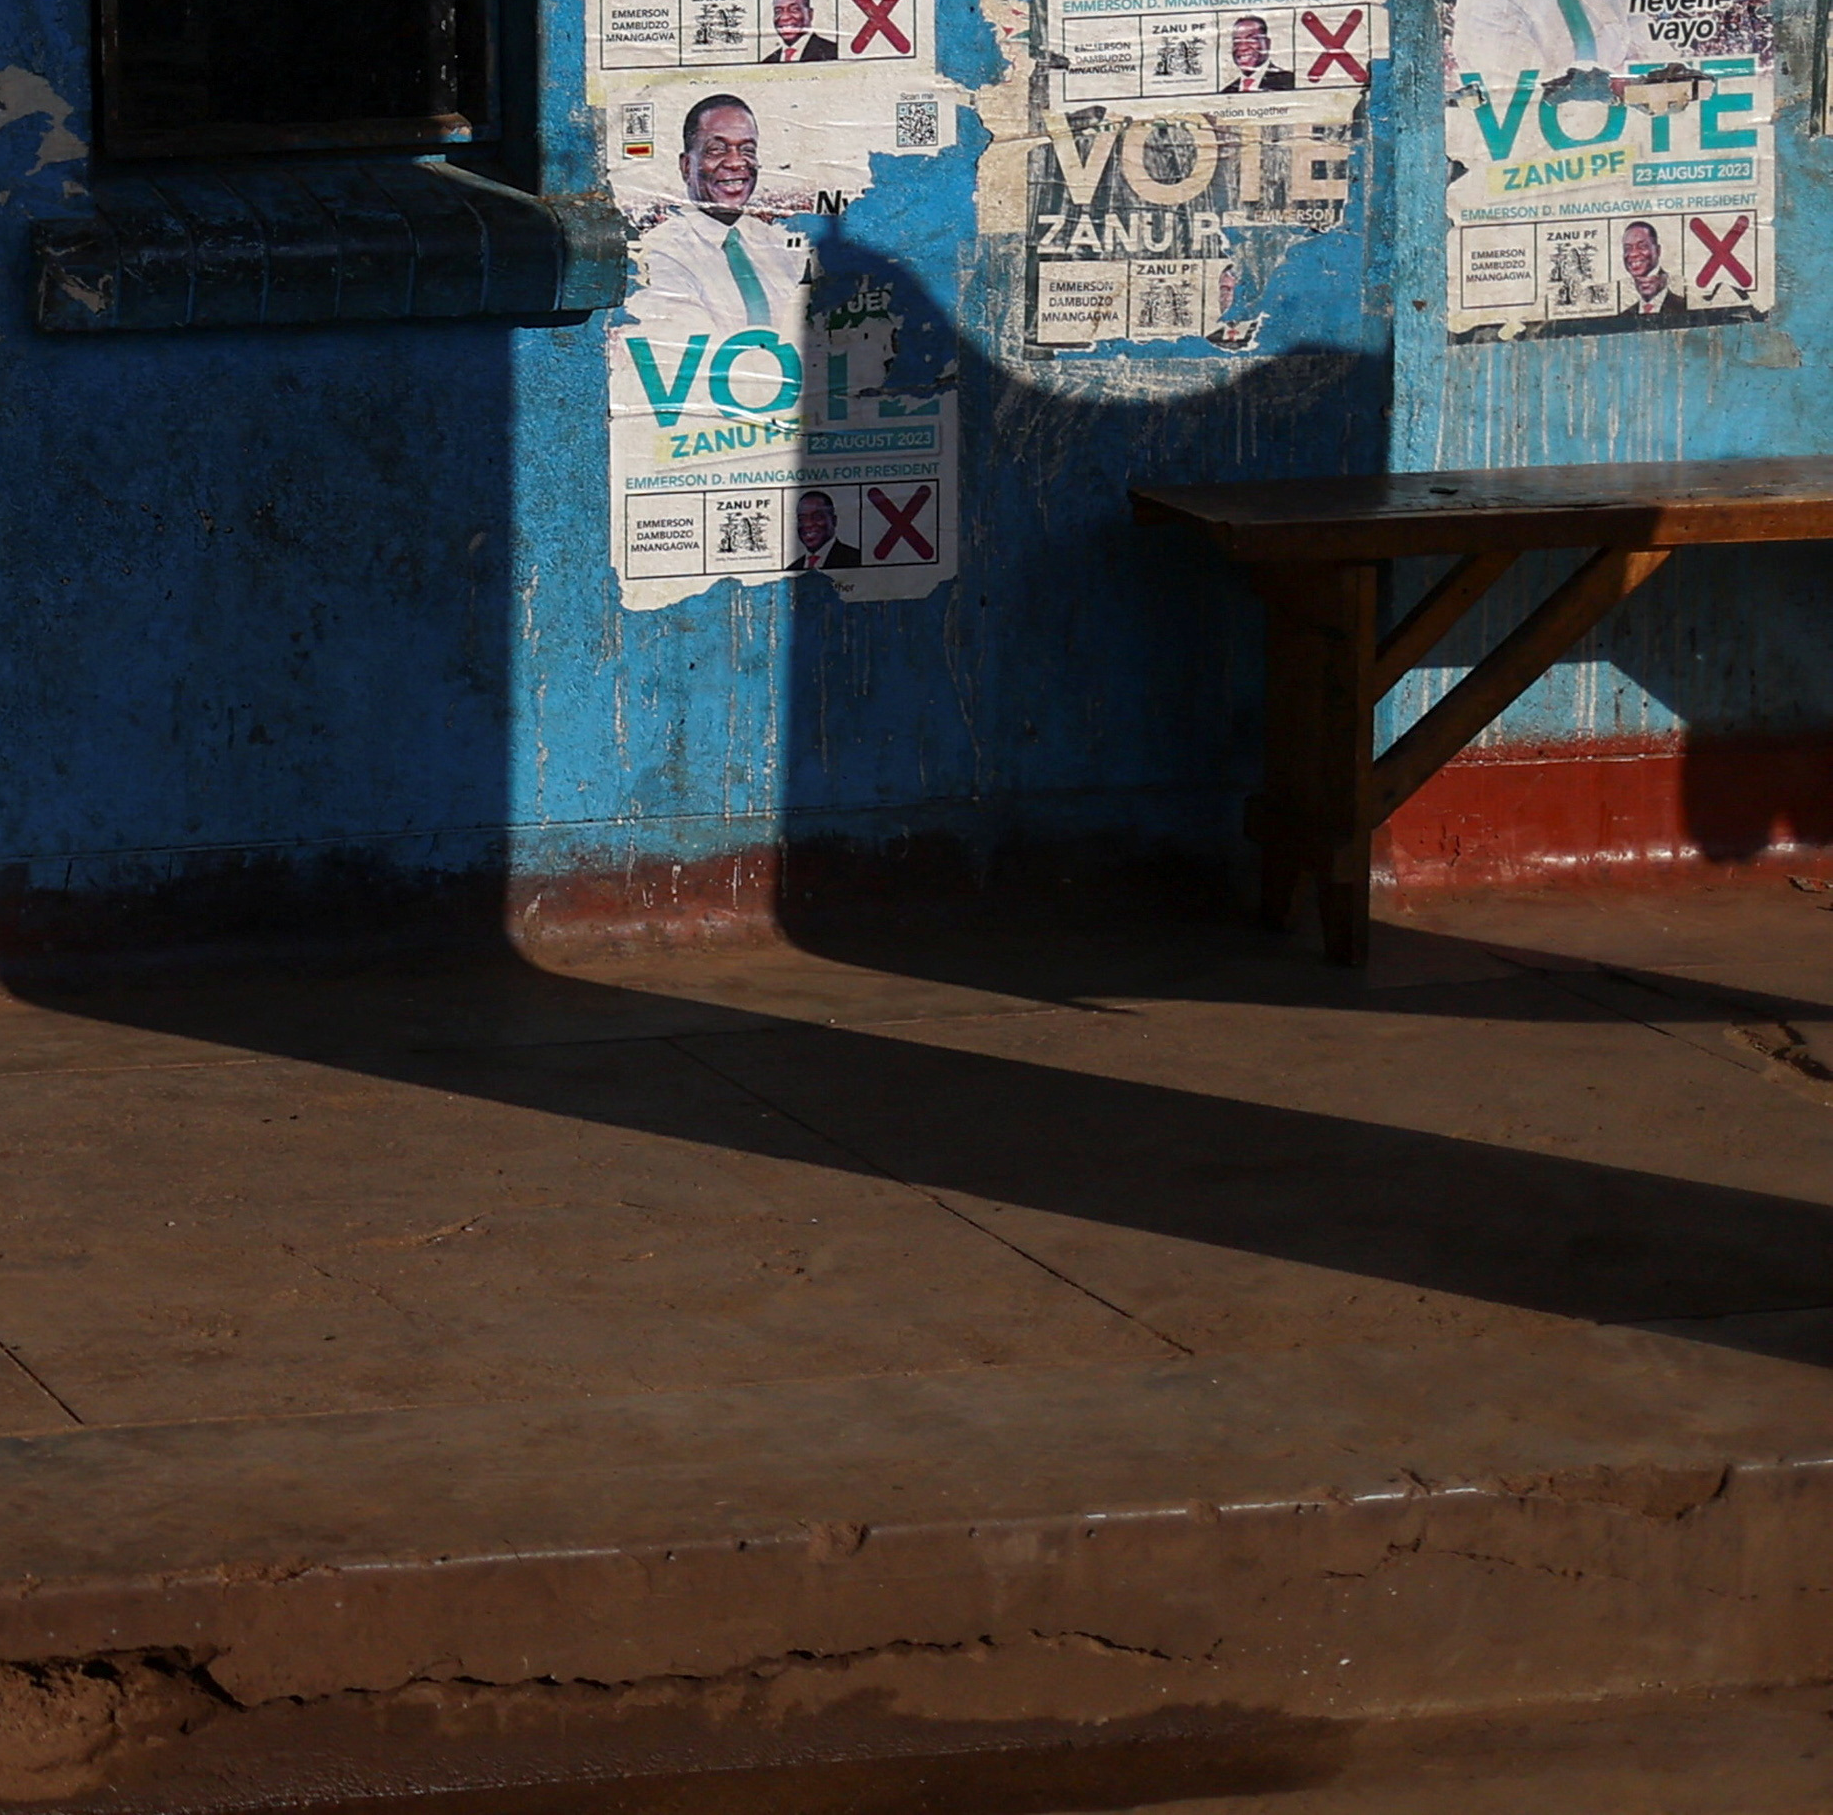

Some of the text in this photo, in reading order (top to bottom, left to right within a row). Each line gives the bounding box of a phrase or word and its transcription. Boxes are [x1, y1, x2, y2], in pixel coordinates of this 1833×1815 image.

[1650, 21, 1715, 47] vayo
[1636, 162, 1750, 182] 23 AUGUST 2023
[1048, 281, 1115, 295] EMMERSON
[1048, 297, 1115, 309] DAMBUDZO
[1042, 310, 1119, 323] MNANGAGWA
